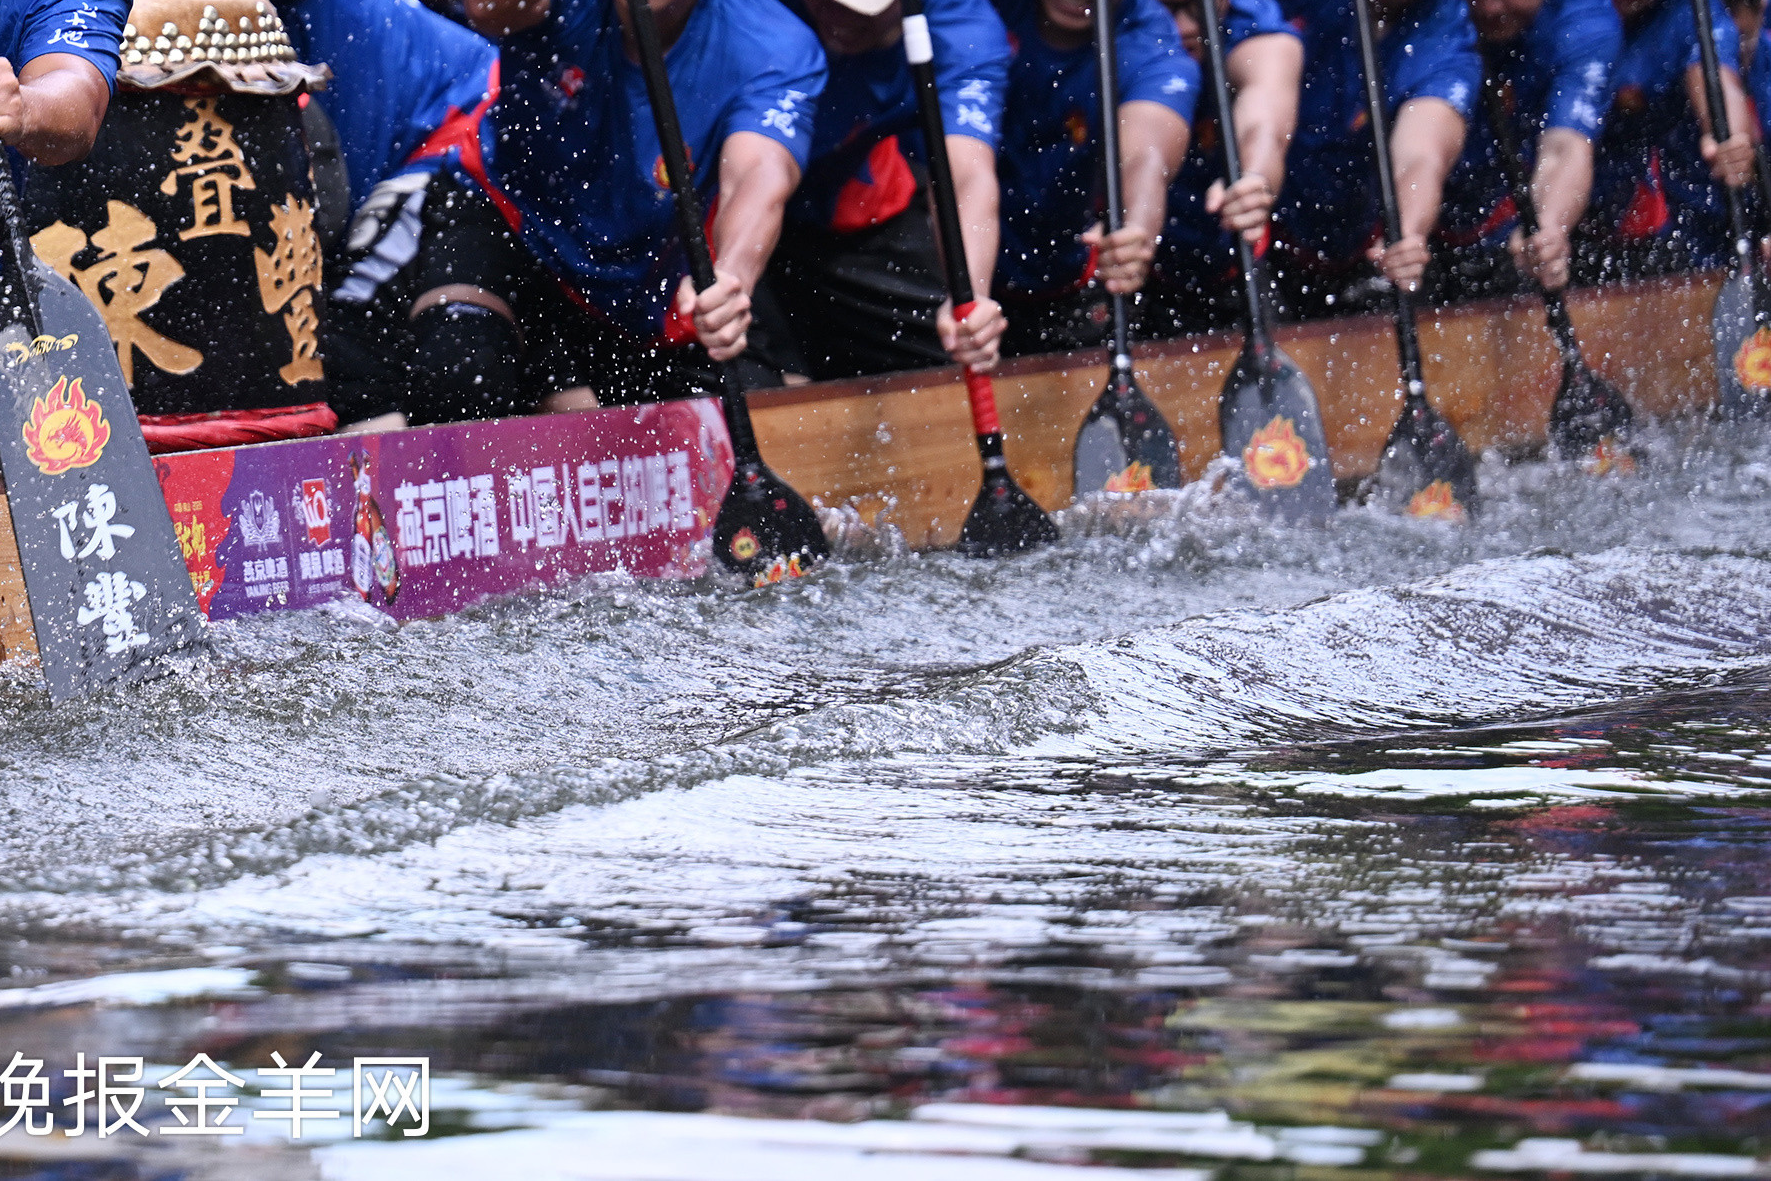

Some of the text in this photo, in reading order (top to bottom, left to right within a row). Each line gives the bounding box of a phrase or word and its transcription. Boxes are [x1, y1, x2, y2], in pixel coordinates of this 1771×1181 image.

[160, 97, 256, 242] 疊
[394, 450, 695, 566] 燕京啤酒 中国人自己的啤酒
[242, 556, 289, 582] 燕京啤酒
